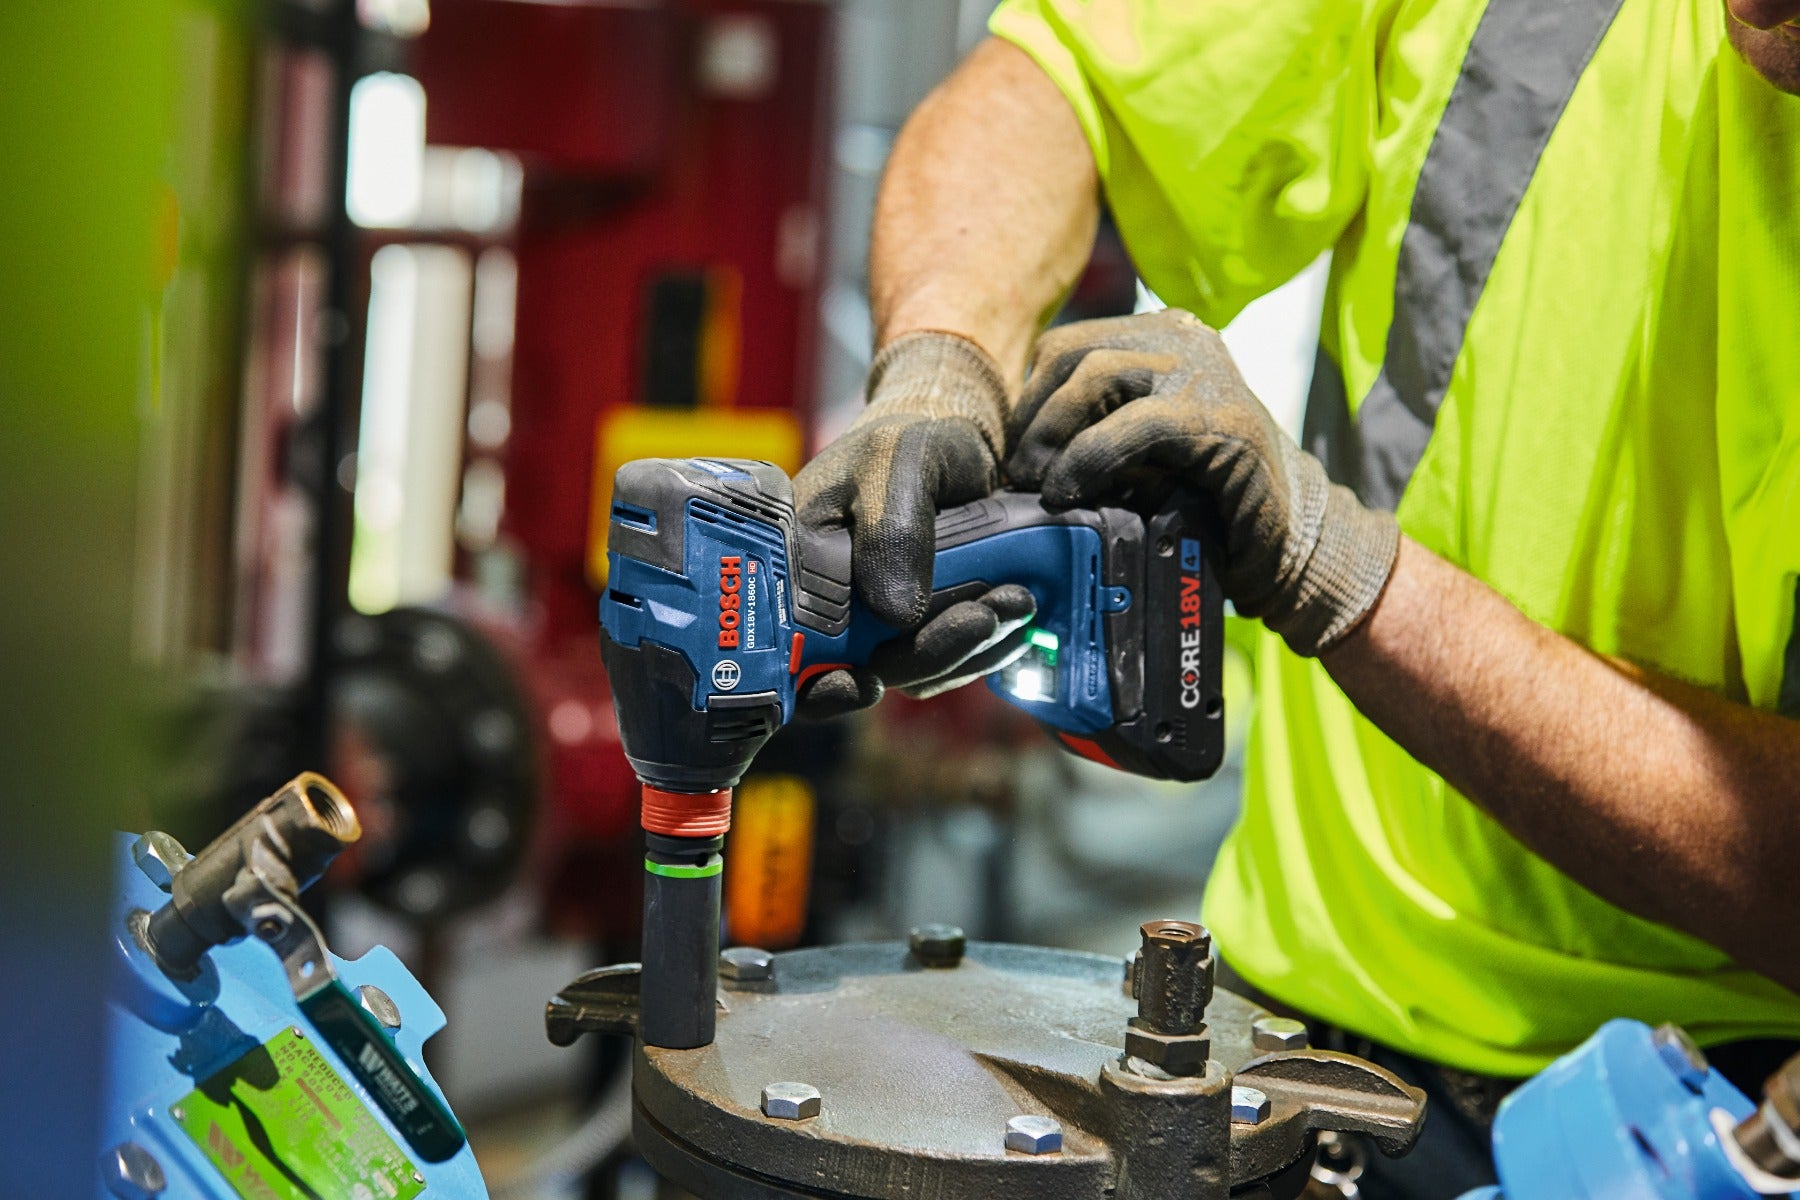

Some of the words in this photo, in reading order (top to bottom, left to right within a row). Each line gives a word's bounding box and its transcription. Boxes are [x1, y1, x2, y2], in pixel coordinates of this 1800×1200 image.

[748, 561, 756, 573] HD
[718, 556, 742, 648] BOSCH
[746, 576, 757, 649] GDX18V-1860C
[288, 1040, 342, 1102] BACKFLOW
[306, 1048, 352, 1100] REDUCED
[377, 1066, 419, 1110] WATTS
